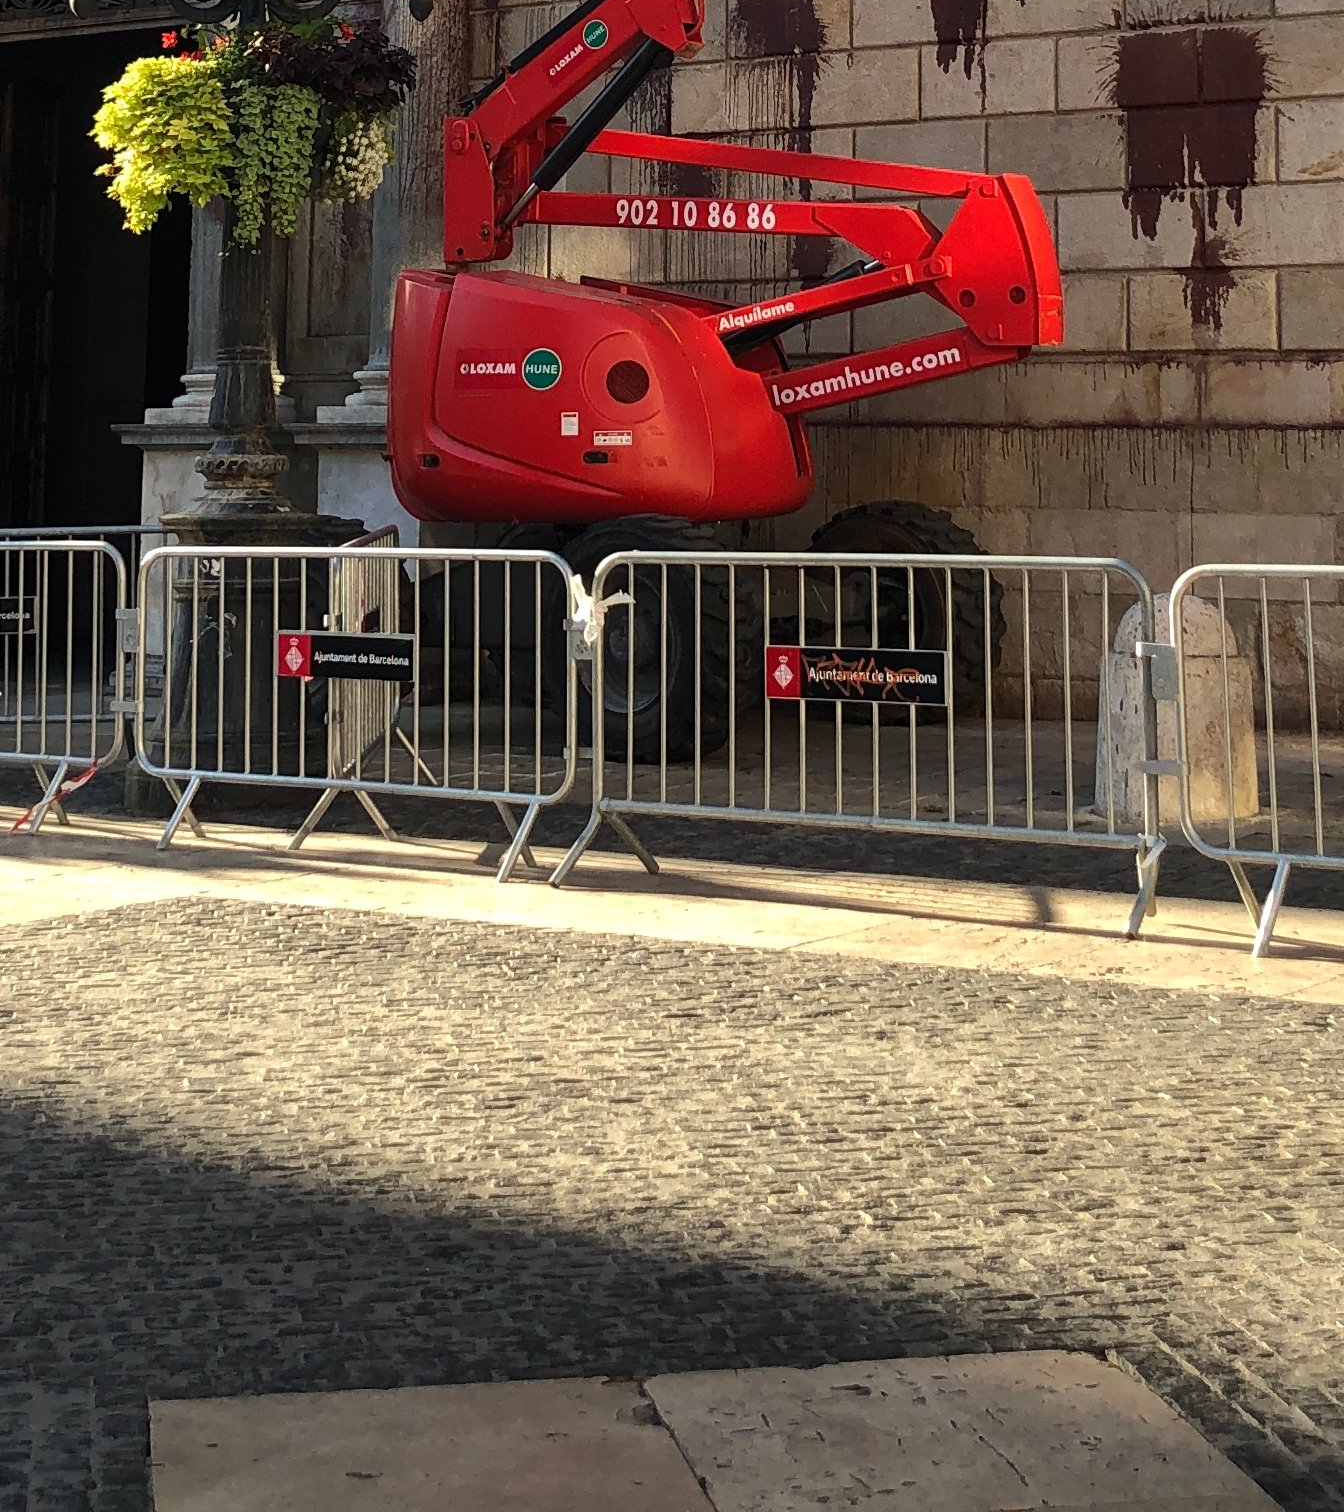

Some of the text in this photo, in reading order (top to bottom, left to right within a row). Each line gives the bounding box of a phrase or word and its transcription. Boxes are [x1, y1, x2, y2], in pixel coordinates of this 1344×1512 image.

[586, 25, 606, 44] HUNE
[616, 199, 776, 230] 902 10 86 86
[525, 363, 558, 375] HUNE
[772, 346, 961, 407] loxamhune.com
[313, 650, 410, 667] Ajuntament de Barcelona
[809, 666, 938, 685] Ajuntament de Barcelona
